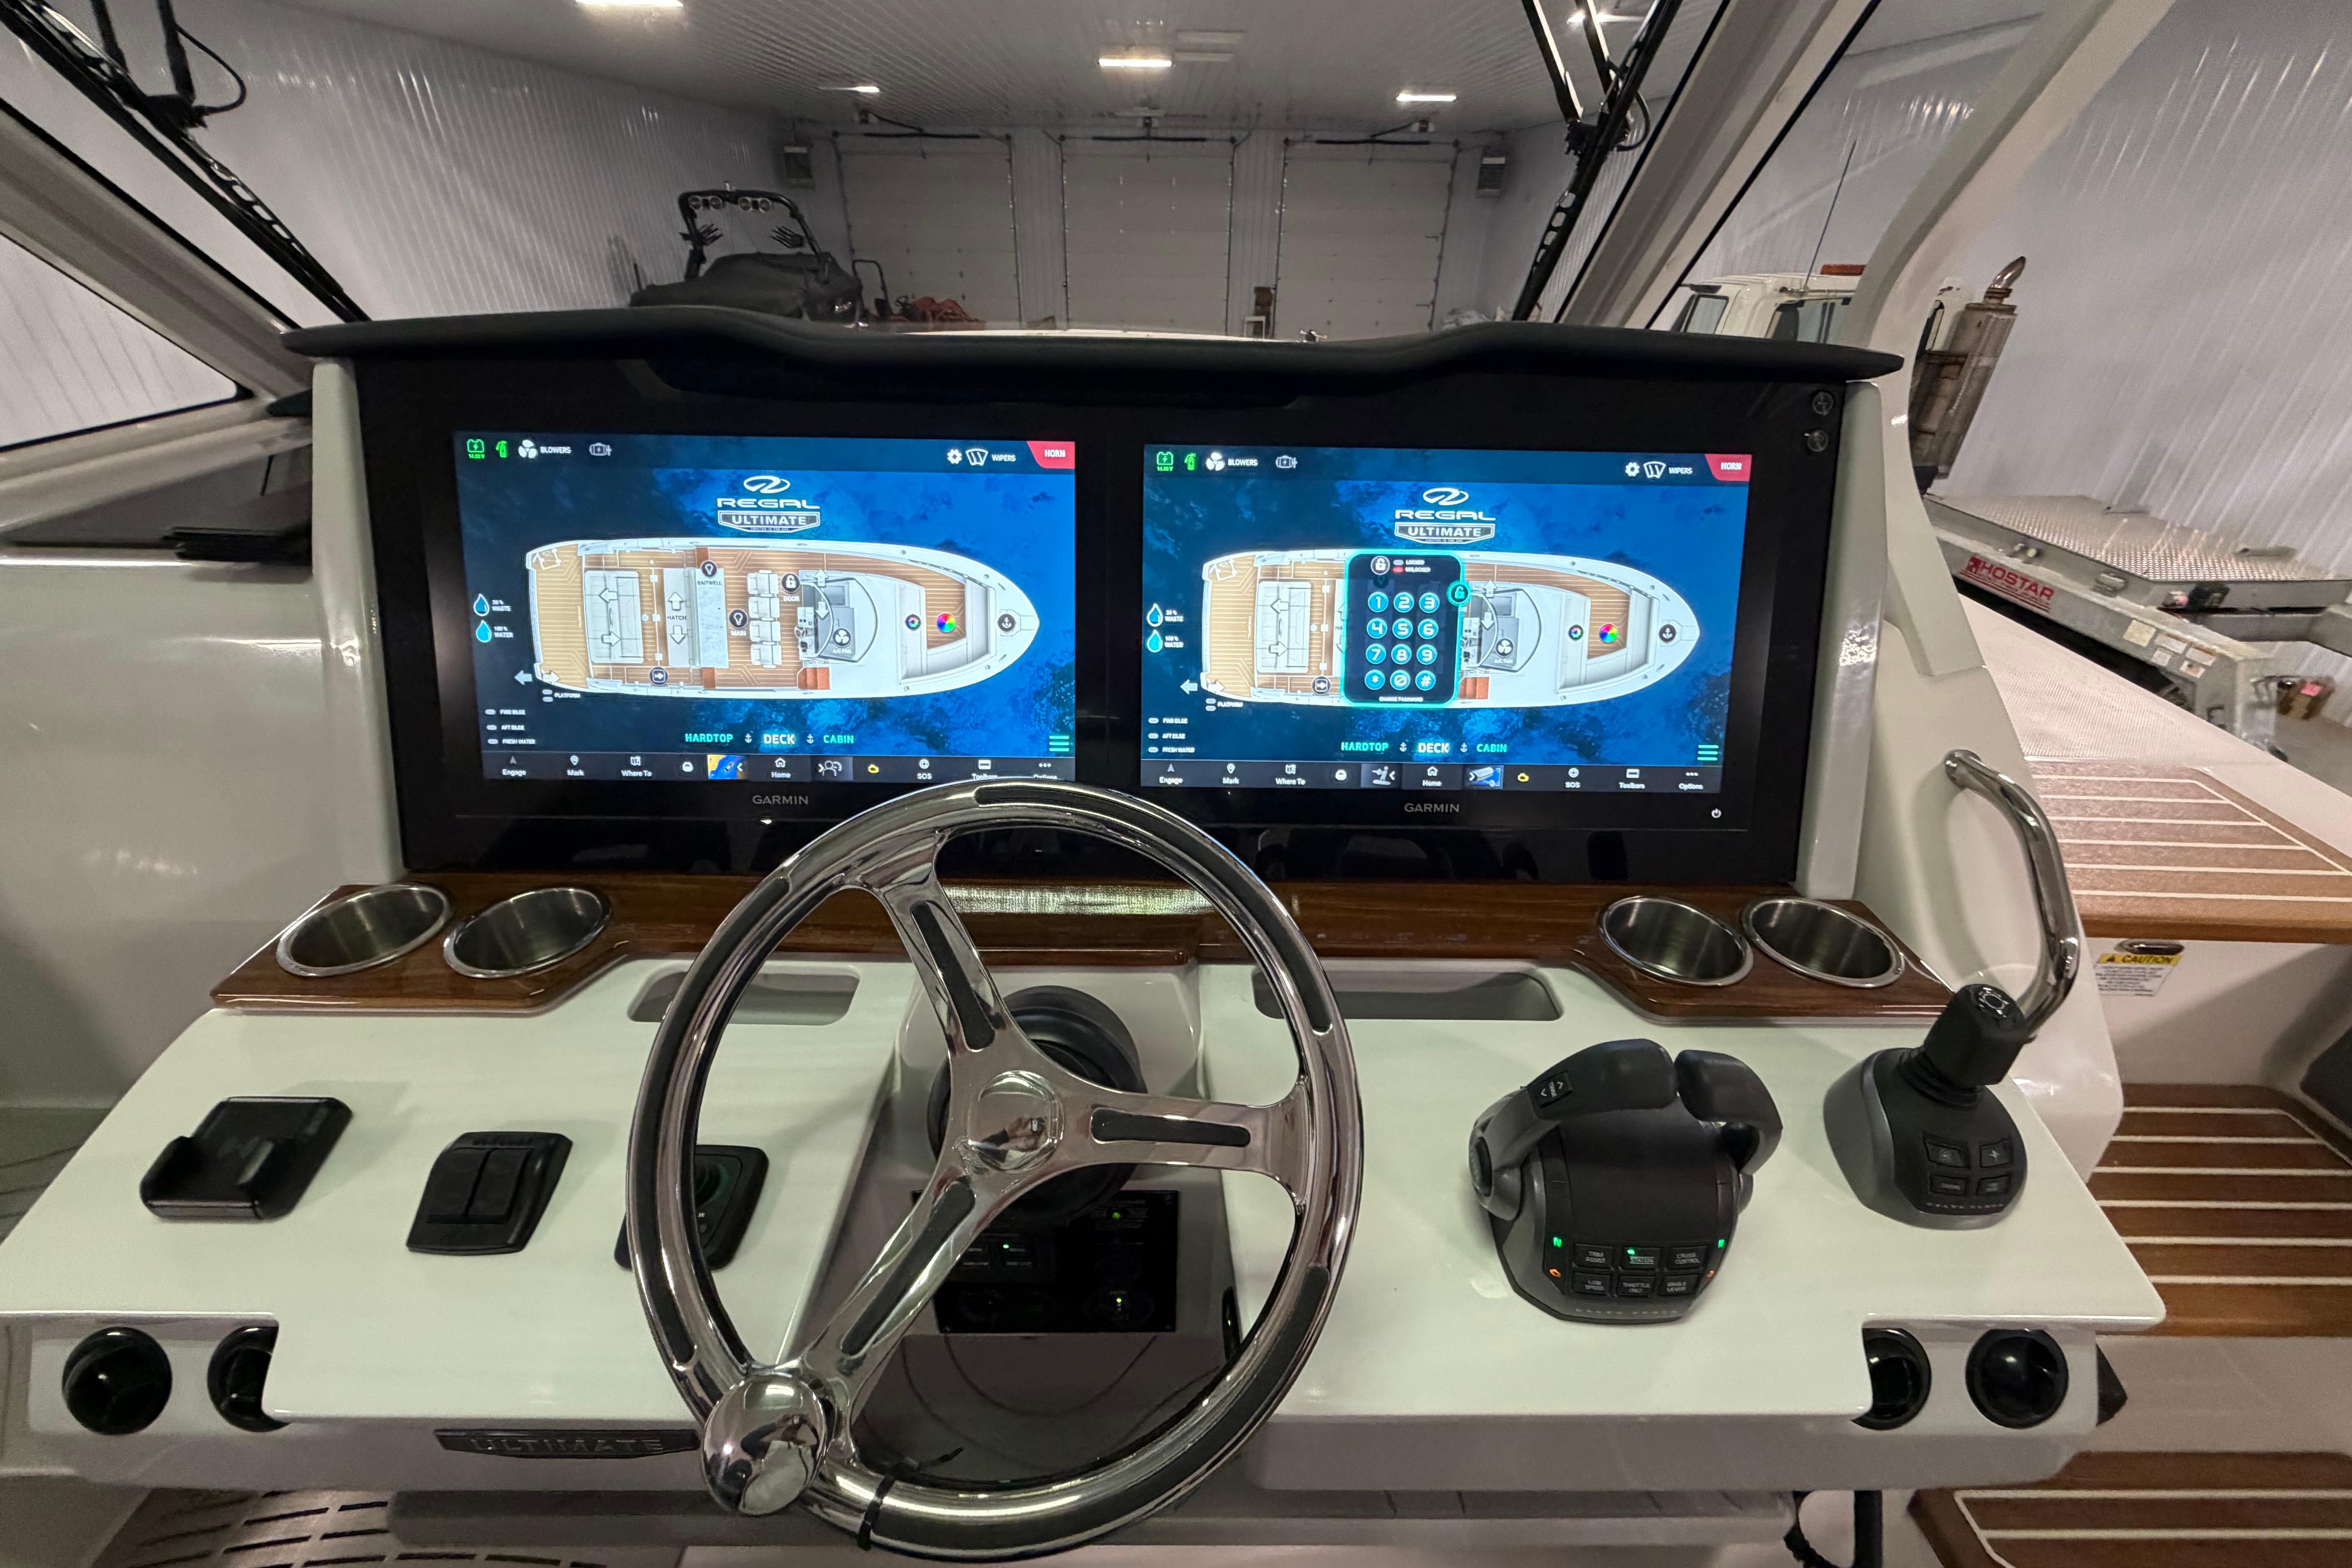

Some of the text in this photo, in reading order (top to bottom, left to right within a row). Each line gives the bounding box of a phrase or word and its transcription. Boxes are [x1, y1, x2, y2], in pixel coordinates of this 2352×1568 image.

[1044, 449, 1066, 458] HORN
[1720, 462, 1742, 470] HORN
[717, 498, 820, 509] REGAL
[732, 515, 807, 525] ULTIMATE
[1395, 510, 1496, 521] REGAL
[1408, 526, 1482, 537] ULTIMATE
[1979, 562, 2055, 601] HOSTAR
[1376, 596, 1435, 609] 1 2 3
[1372, 623, 1434, 635] 4 5 6
[1371, 649, 1433, 661] 7 8 9
[1394, 674, 1407, 686] 0
[685, 733, 854, 744] HARDTOP DECK CABIN
[1341, 742, 1507, 753] HARDTOP DECK CABIN
[752, 795, 809, 805] GARMIN
[1404, 803, 1460, 813] GARMIN
